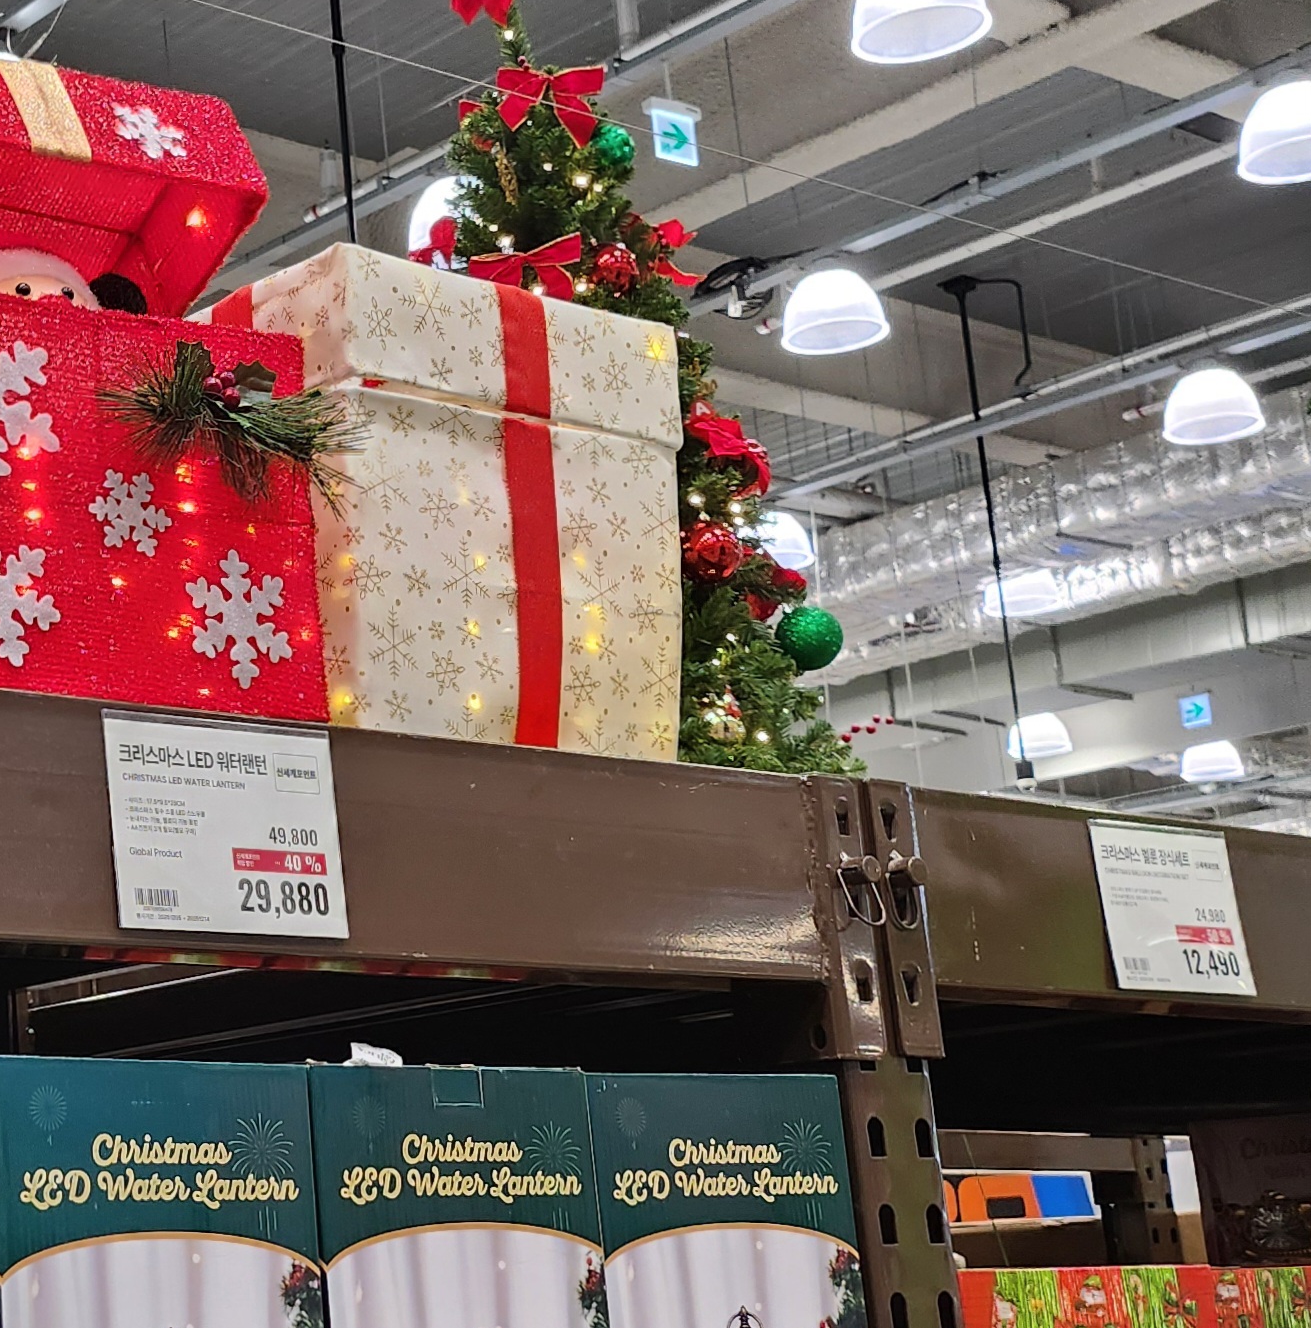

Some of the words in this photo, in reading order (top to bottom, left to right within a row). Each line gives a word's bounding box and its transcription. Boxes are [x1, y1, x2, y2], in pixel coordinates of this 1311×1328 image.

[119, 743, 185, 768] 크리스마스
[187, 750, 214, 769] LED
[216, 751, 269, 776] 워터랜턴
[122, 772, 167, 784] CHRISTMAS
[168, 776, 183, 786] LED
[184, 777, 211, 788] WATER
[212, 779, 246, 790] LANTERN
[129, 847, 152, 857] Global
[154, 848, 183, 858] Product
[269, 827, 318, 847] 49,800
[1101, 844, 1141, 864] 크리스마스
[1158, 850, 1190, 867] 장식세트
[238, 878, 330, 918] 29,880
[1195, 907, 1226, 923] 24,980
[1182, 948, 1241, 980] 12,490
[93, 1132, 233, 1168] Christmas
[402, 1133, 523, 1166] Christmas
[668, 1138, 783, 1168] Christmas
[20, 1169, 91, 1211] LED
[97, 1171, 191, 1203] Water
[192, 1169, 299, 1210] Lantern
[340, 1166, 402, 1206] LED
[407, 1166, 488, 1197] Water
[489, 1168, 582, 1203] Lantern
[613, 1170, 670, 1206] LED
[674, 1169, 750, 1198] Water
[751, 1169, 838, 1203] Lantern
